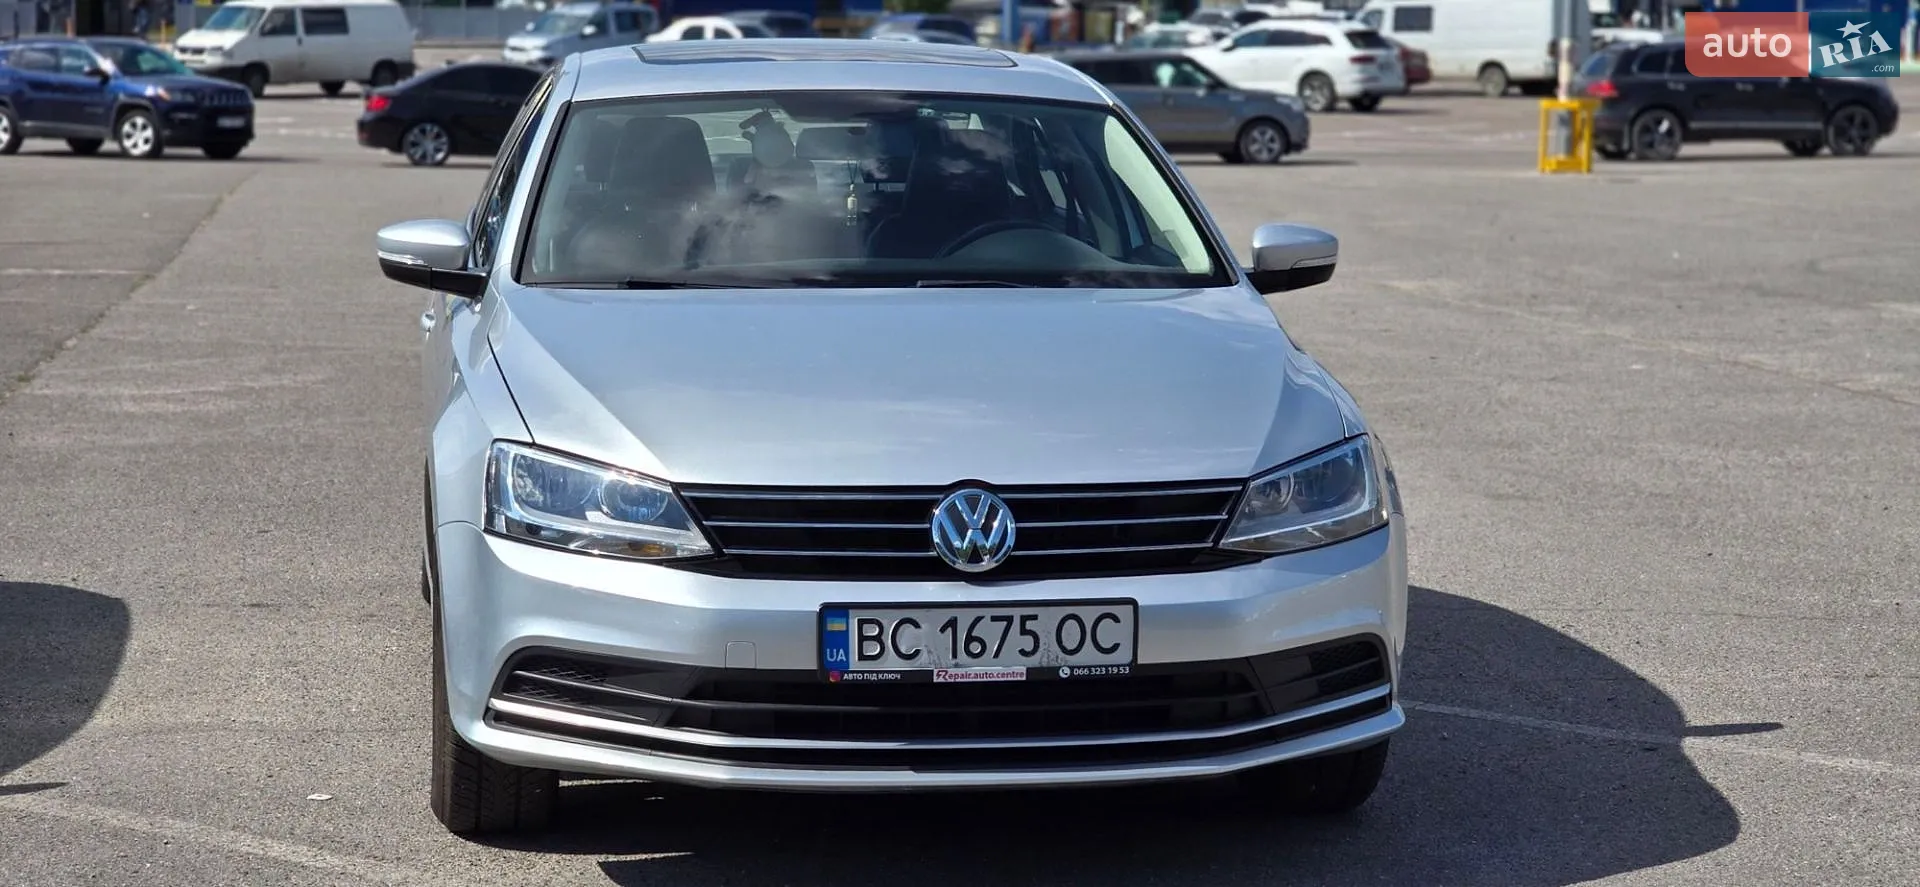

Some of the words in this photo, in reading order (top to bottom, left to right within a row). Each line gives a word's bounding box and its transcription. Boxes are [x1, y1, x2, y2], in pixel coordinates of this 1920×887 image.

[855, 616, 922, 662] BC
[938, 614, 1041, 660] 1675
[1055, 612, 1122, 656] OC
[826, 649, 846, 662] UA
[1073, 667, 1089, 675] 066
[1090, 667, 1106, 675] 323
[1108, 666, 1118, 674] 19
[1119, 666, 1130, 674] 53
